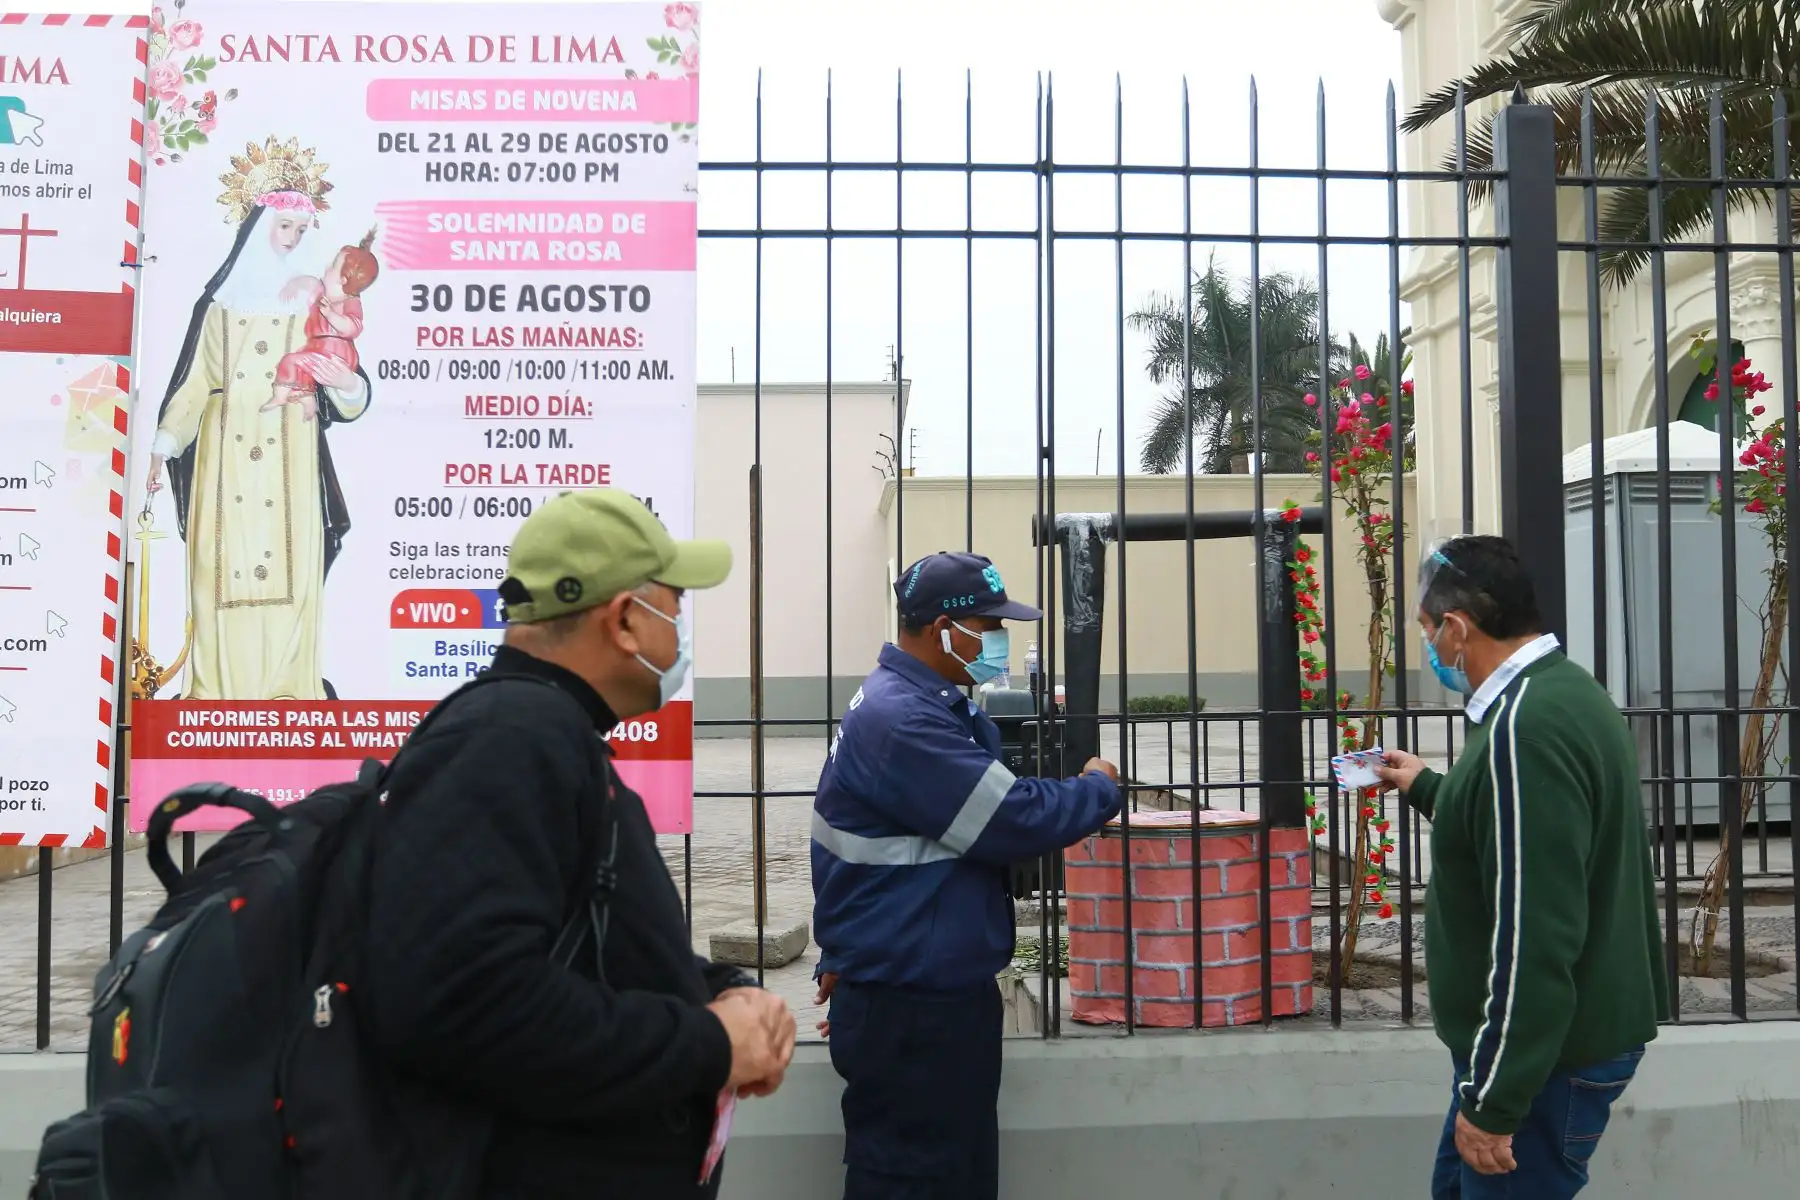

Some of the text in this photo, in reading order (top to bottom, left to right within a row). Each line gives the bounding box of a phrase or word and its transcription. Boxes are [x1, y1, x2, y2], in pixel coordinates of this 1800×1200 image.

[219, 34, 626, 63] SANTA ROSA DE LIMA
[410, 89, 637, 111] MISAS DE NOVENA
[378, 132, 669, 153] DEL 21 AL 29 DE AGOSTO
[10, 158, 30, 174] de
[35, 159, 73, 175] Lima
[425, 162, 619, 183] HORA: 07:00 PM
[36, 182, 73, 198] abrir
[78, 183, 92, 199] el
[428, 213, 646, 234] SOLEMNIDAD DE
[450, 240, 622, 261] SANTA ROSA
[410, 284, 651, 312] 30 DE AGOSTO
[416, 321, 644, 348] POR LAS MAÑANAS:
[378, 359, 430, 380] 08:00
[449, 360, 501, 381] 09:00
[637, 360, 674, 381] AM.
[465, 389, 593, 417] MEDIO DÍA:
[483, 428, 574, 449] 12:00 M.
[445, 464, 611, 485] POR LA TARDE
[394, 496, 453, 517] 05:00
[473, 497, 532, 518] 06:00
[390, 541, 428, 560] Siga
[435, 541, 460, 557] las
[409, 602, 456, 623] VIVO
[405, 661, 458, 677] Santa
[179, 710, 430, 727] INFORMES PARA LAS MIS
[167, 721, 658, 748] COMUNITARIAS AL WHAT 408
[9, 780, 49, 793] pozo
[267, 788, 316, 802] 191-1
[31, 797, 46, 811] ti.
